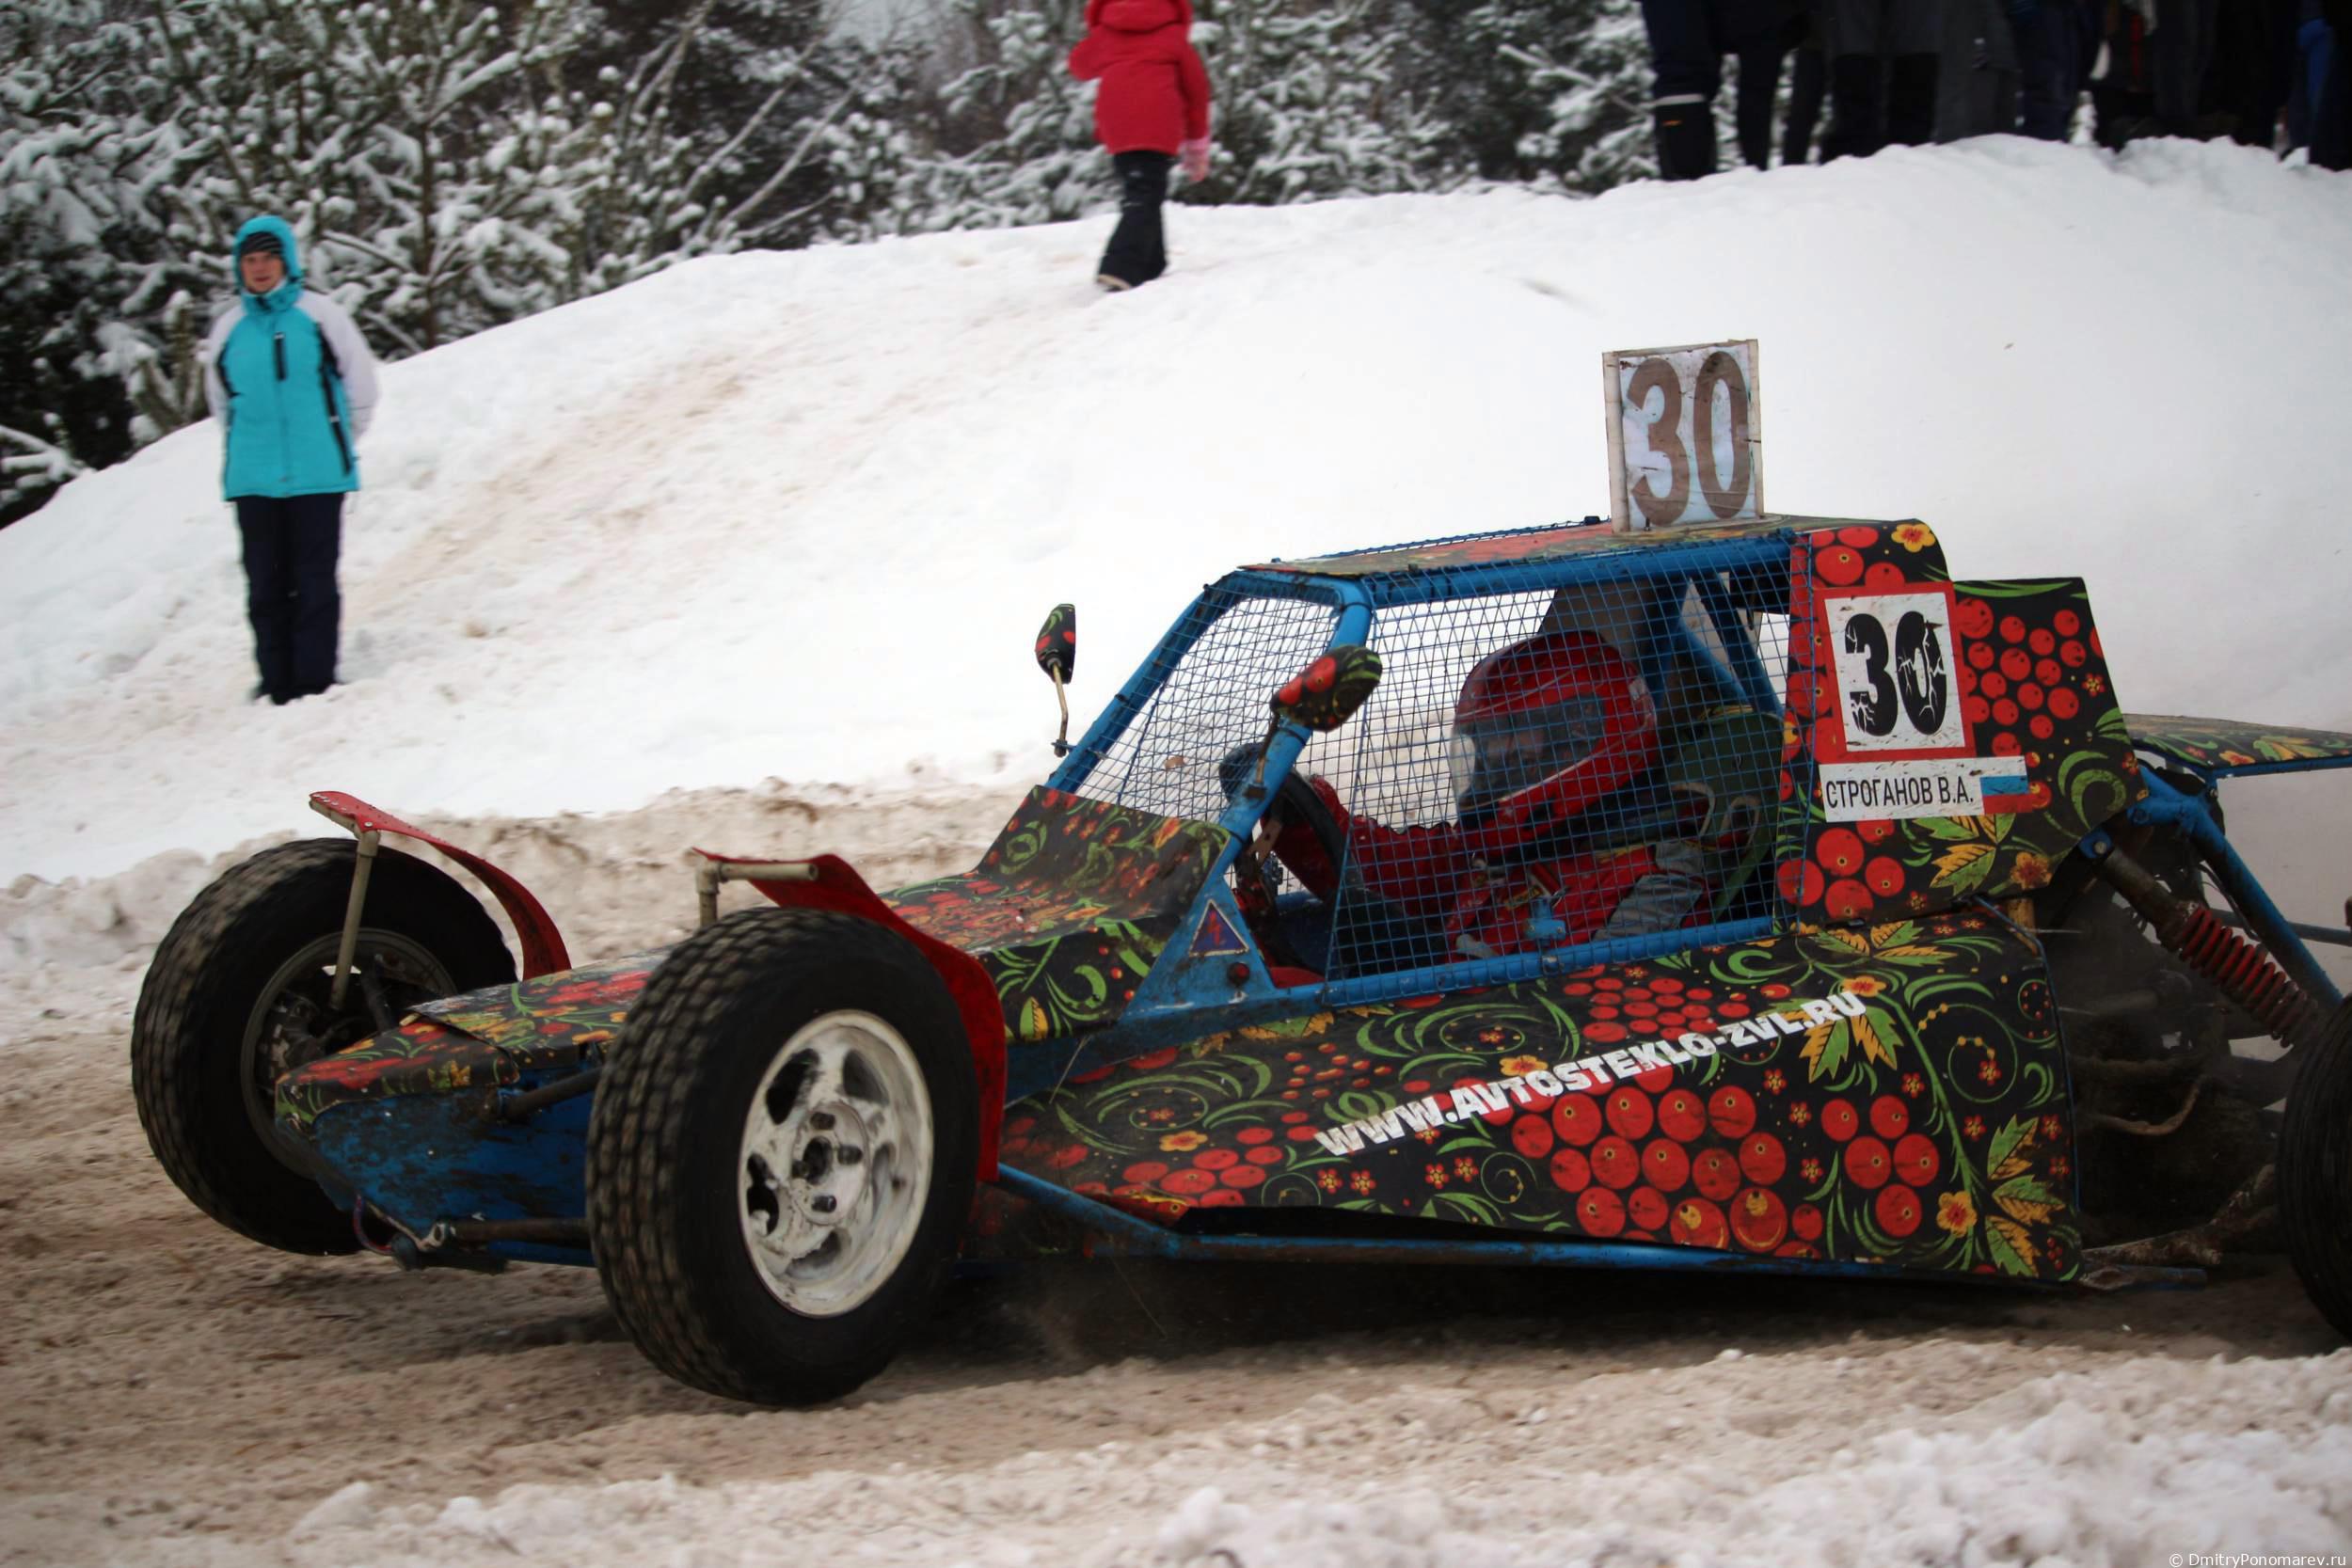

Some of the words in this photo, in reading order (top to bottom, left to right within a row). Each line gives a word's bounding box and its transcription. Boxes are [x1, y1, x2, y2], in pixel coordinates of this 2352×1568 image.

[1627, 351, 1751, 526] 30
[1845, 610, 1947, 736] 30
[1826, 777, 1932, 808] СТРОГАНОВ
[1938, 775, 1974, 804] В.А.
[1314, 991, 1867, 1156] WWW.AVTOSTEKLO-ZVL.RU
